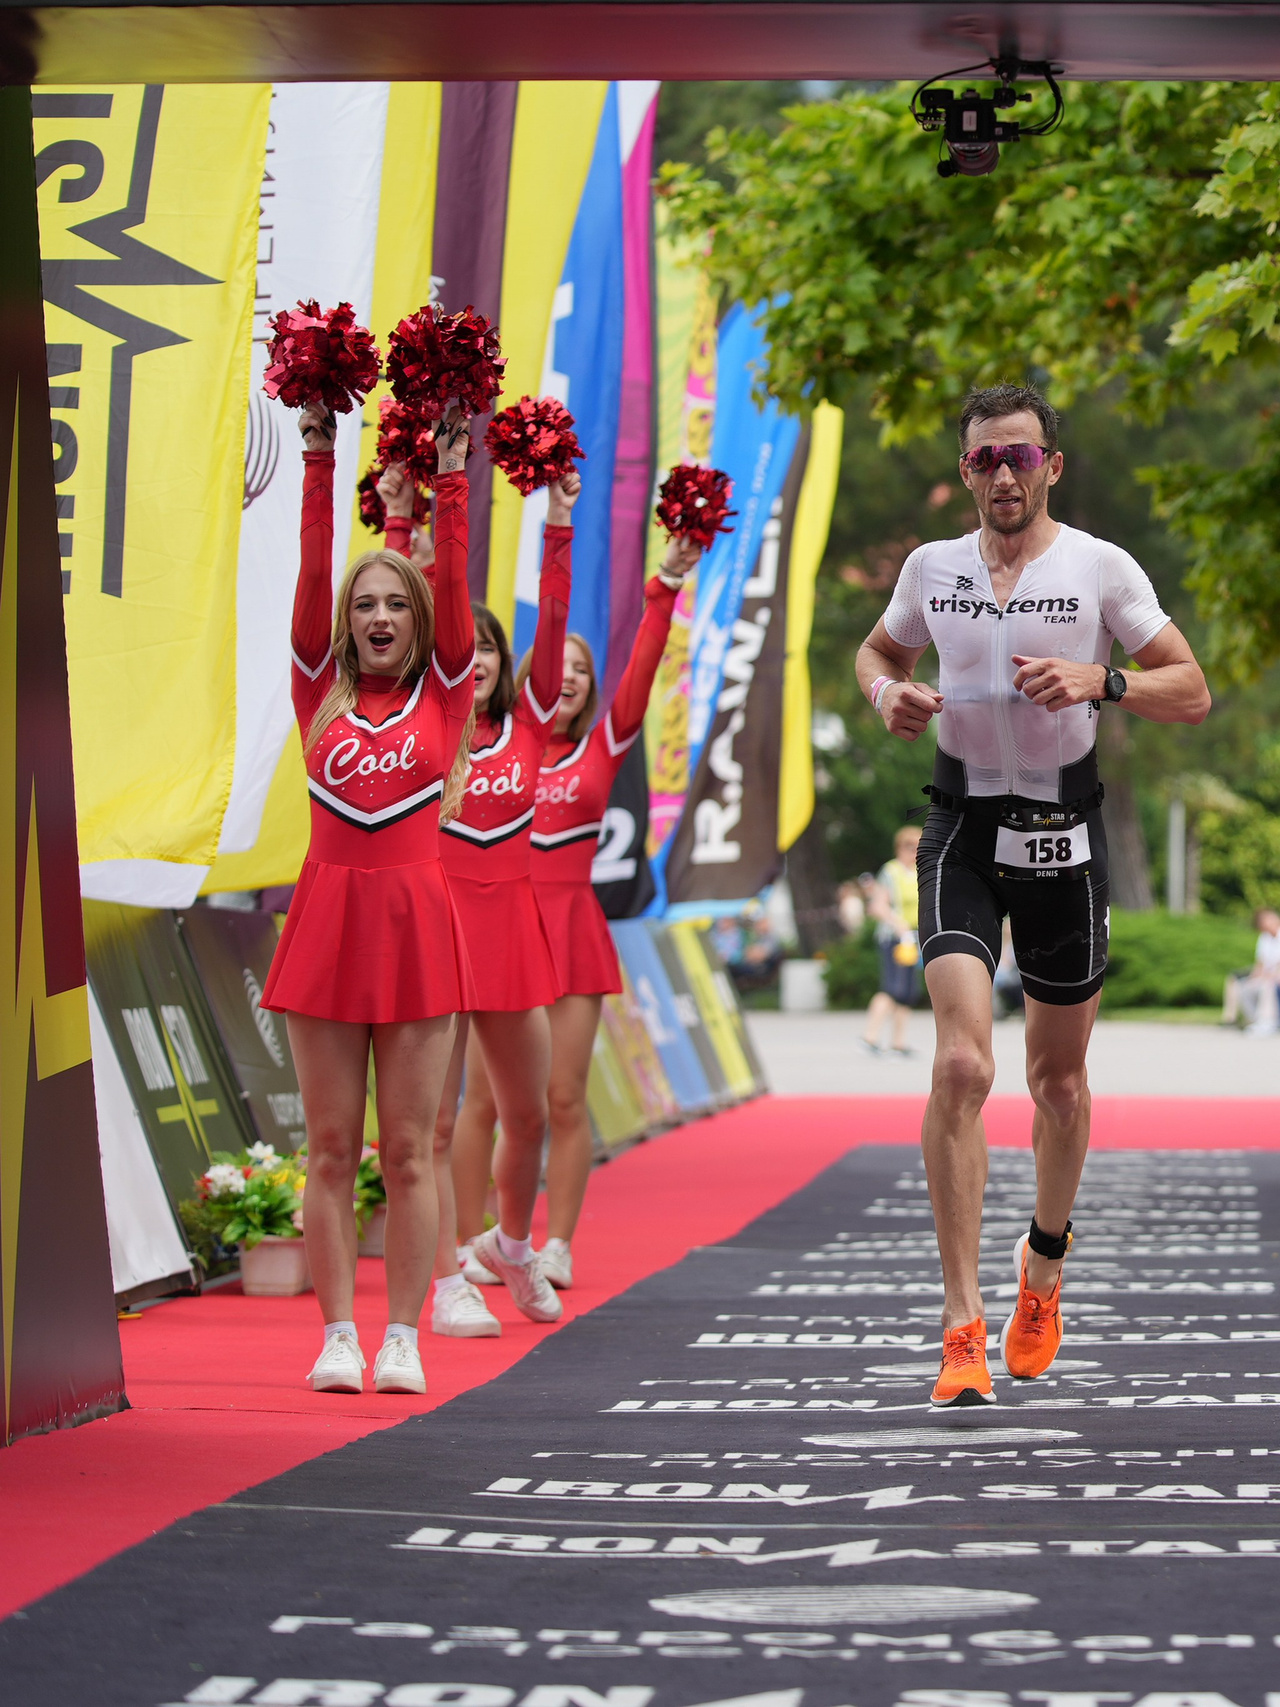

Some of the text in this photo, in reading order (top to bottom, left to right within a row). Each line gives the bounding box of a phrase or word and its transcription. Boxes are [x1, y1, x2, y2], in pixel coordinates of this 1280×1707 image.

[929, 594, 1079, 619] trisystems
[1044, 616, 1077, 624] TEAM
[323, 734, 418, 786] Cool
[457, 761, 526, 796] ool
[535, 775, 580, 804] ool
[1050, 813, 1065, 821] STAR
[1024, 837, 1072, 863] 158
[696, 1333, 924, 1344] IRON
[611, 1399, 878, 1410] IRON
[485, 1477, 810, 1498] IRON
[406, 1527, 765, 1554] IRON
[184, 1675, 655, 1707] IRON
